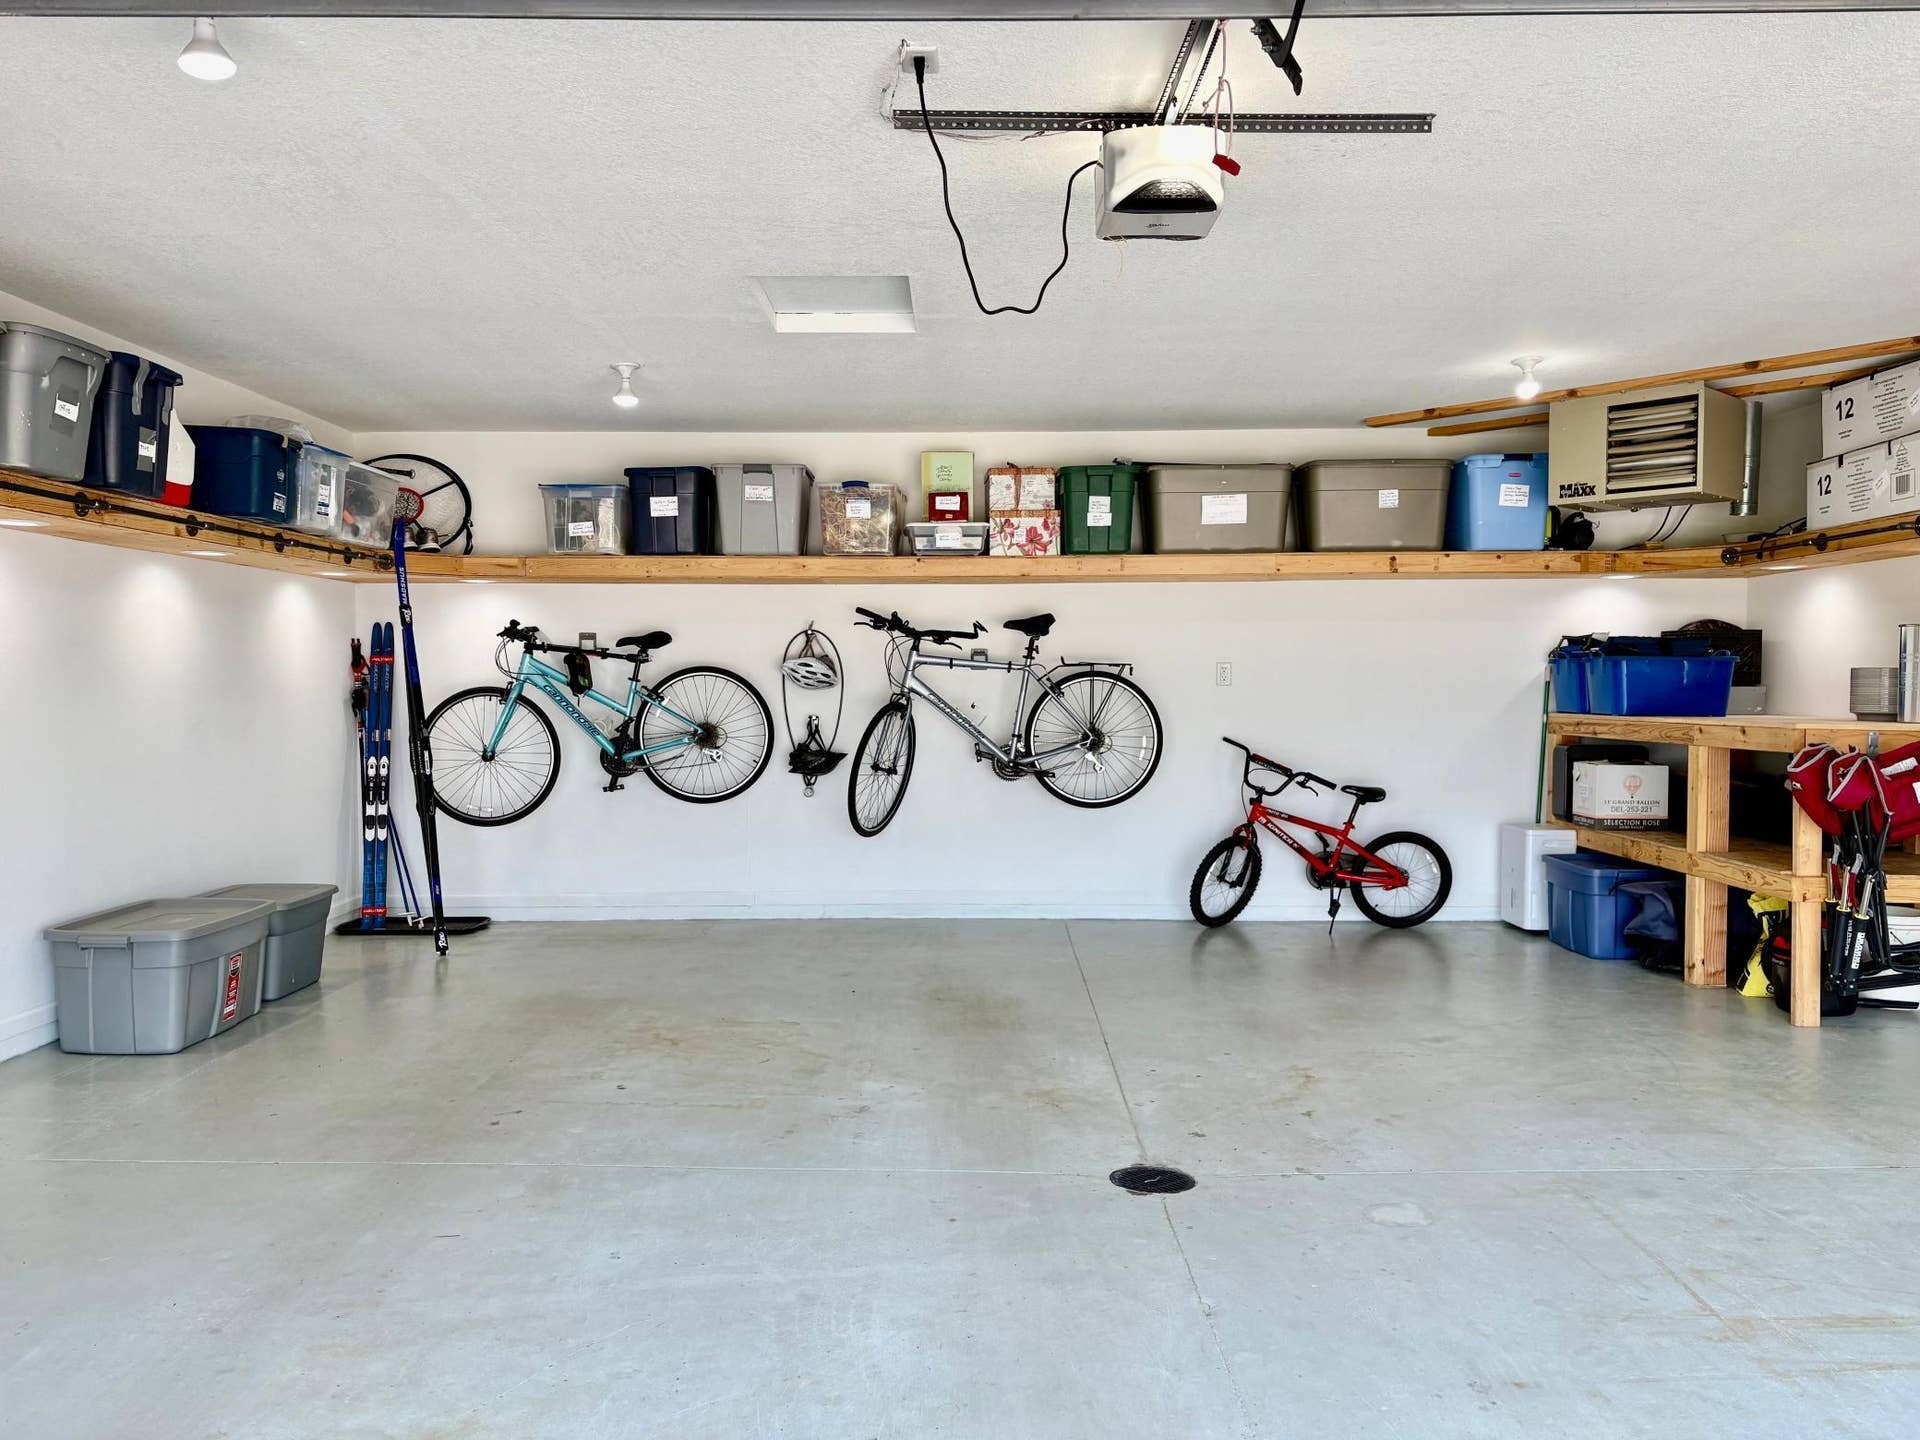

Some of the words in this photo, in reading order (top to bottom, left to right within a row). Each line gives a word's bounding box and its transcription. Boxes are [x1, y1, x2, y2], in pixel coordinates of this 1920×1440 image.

[1836, 397, 1854, 421] 12
[1817, 474, 1831, 497] 12
[1266, 821, 1294, 846] IGNITION
